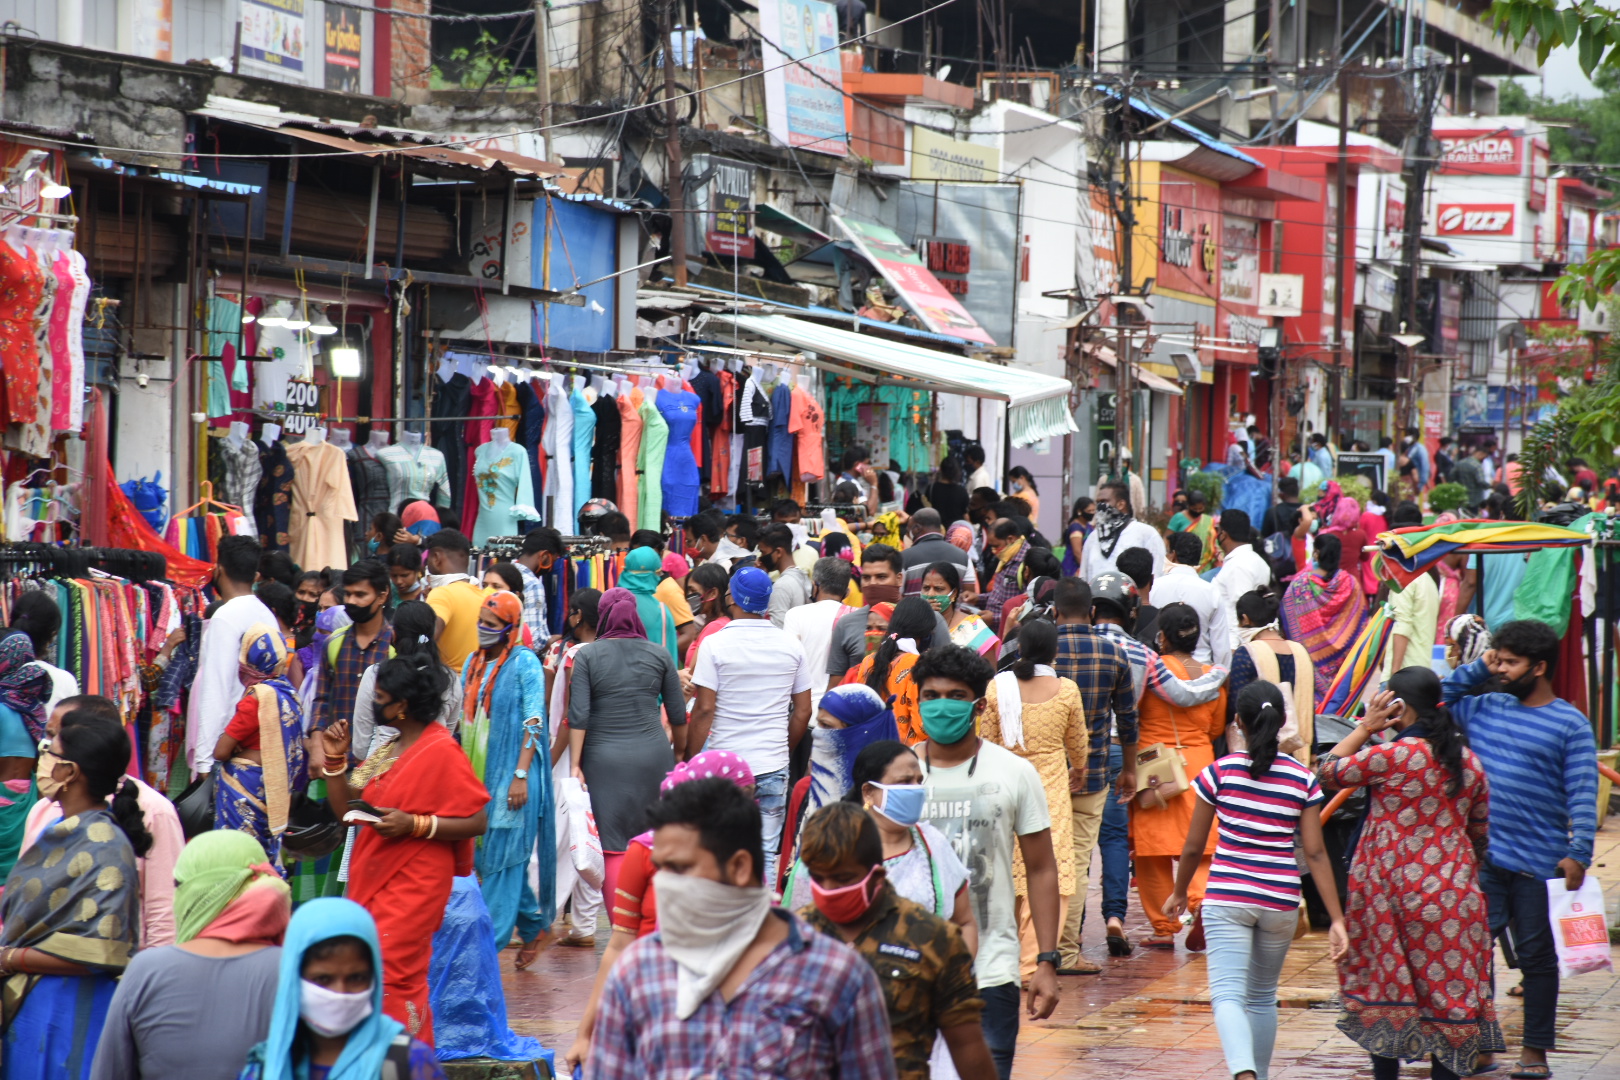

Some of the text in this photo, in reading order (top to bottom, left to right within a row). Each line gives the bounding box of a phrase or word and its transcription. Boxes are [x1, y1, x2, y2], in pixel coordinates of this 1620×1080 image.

[1441, 139, 1514, 154] PANDA
[1484, 153, 1514, 162] MART
[716, 164, 749, 198] SUPRIYA
[287, 382, 318, 407] 200
